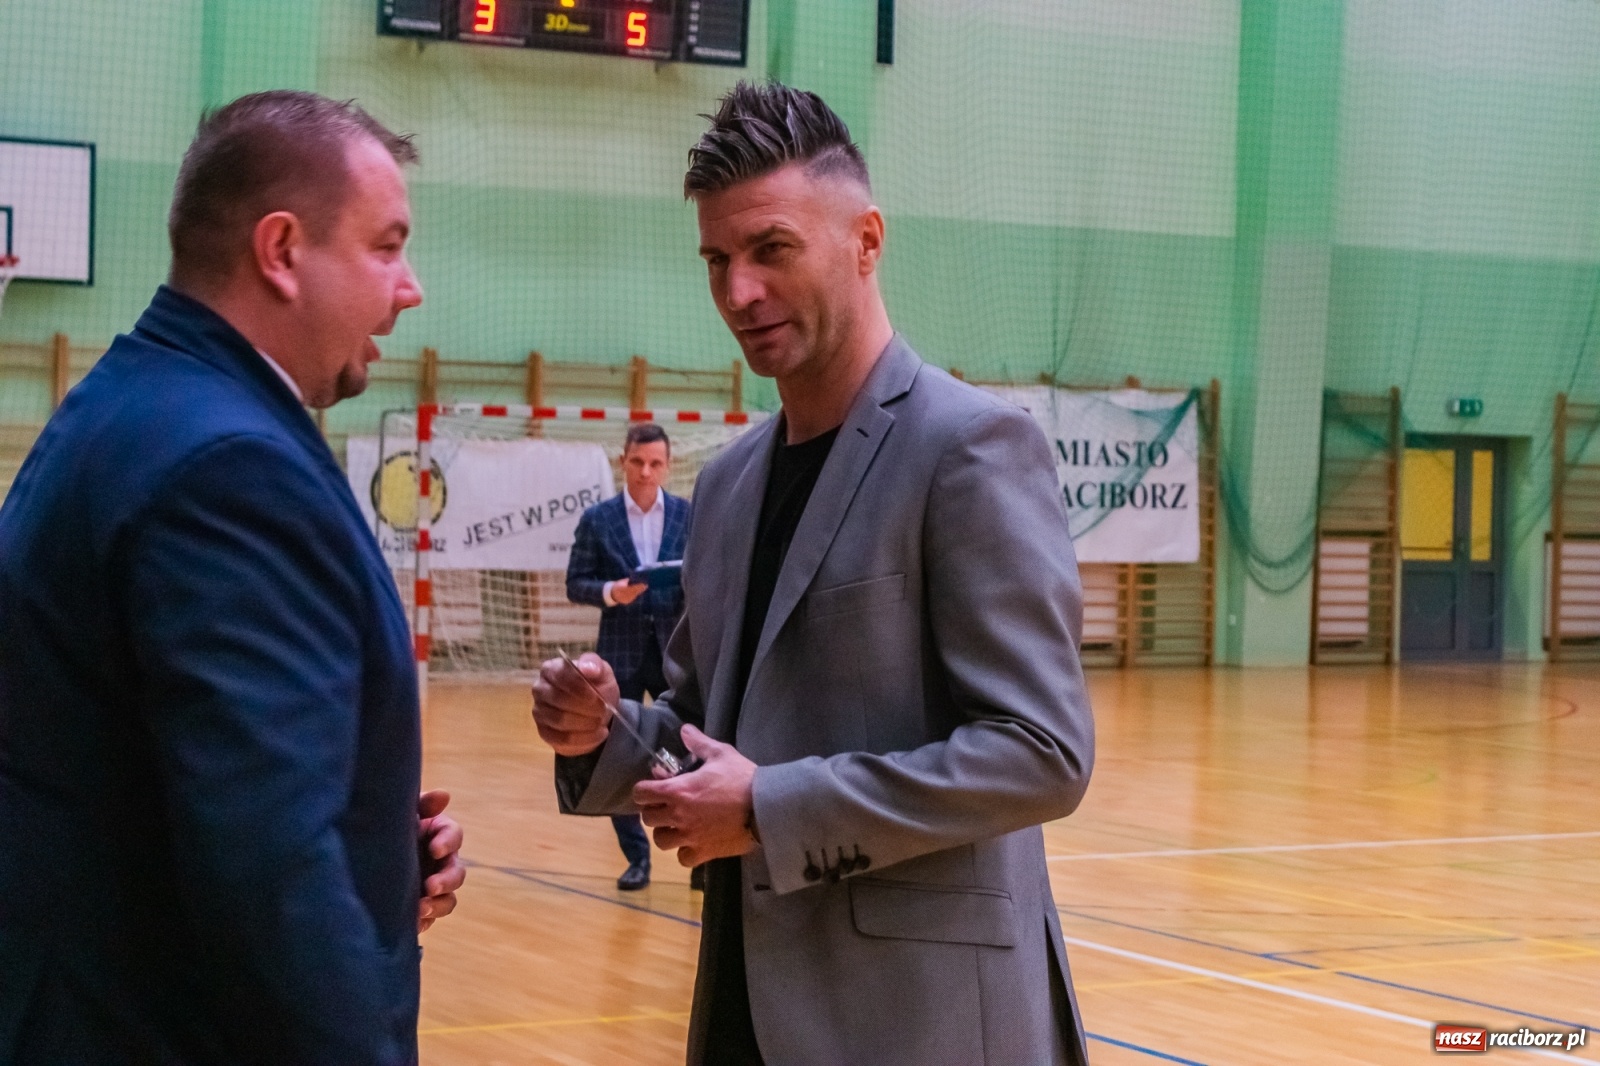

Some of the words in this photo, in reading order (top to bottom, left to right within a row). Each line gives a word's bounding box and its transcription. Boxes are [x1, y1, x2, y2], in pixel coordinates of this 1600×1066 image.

[474, 0, 496, 32] 3
[627, 12, 646, 46] 5
[1056, 440, 1168, 468] MIASTO
[1061, 482, 1187, 510] ACIBORZ
[463, 512, 514, 546] JEST
[521, 505, 542, 527] W
